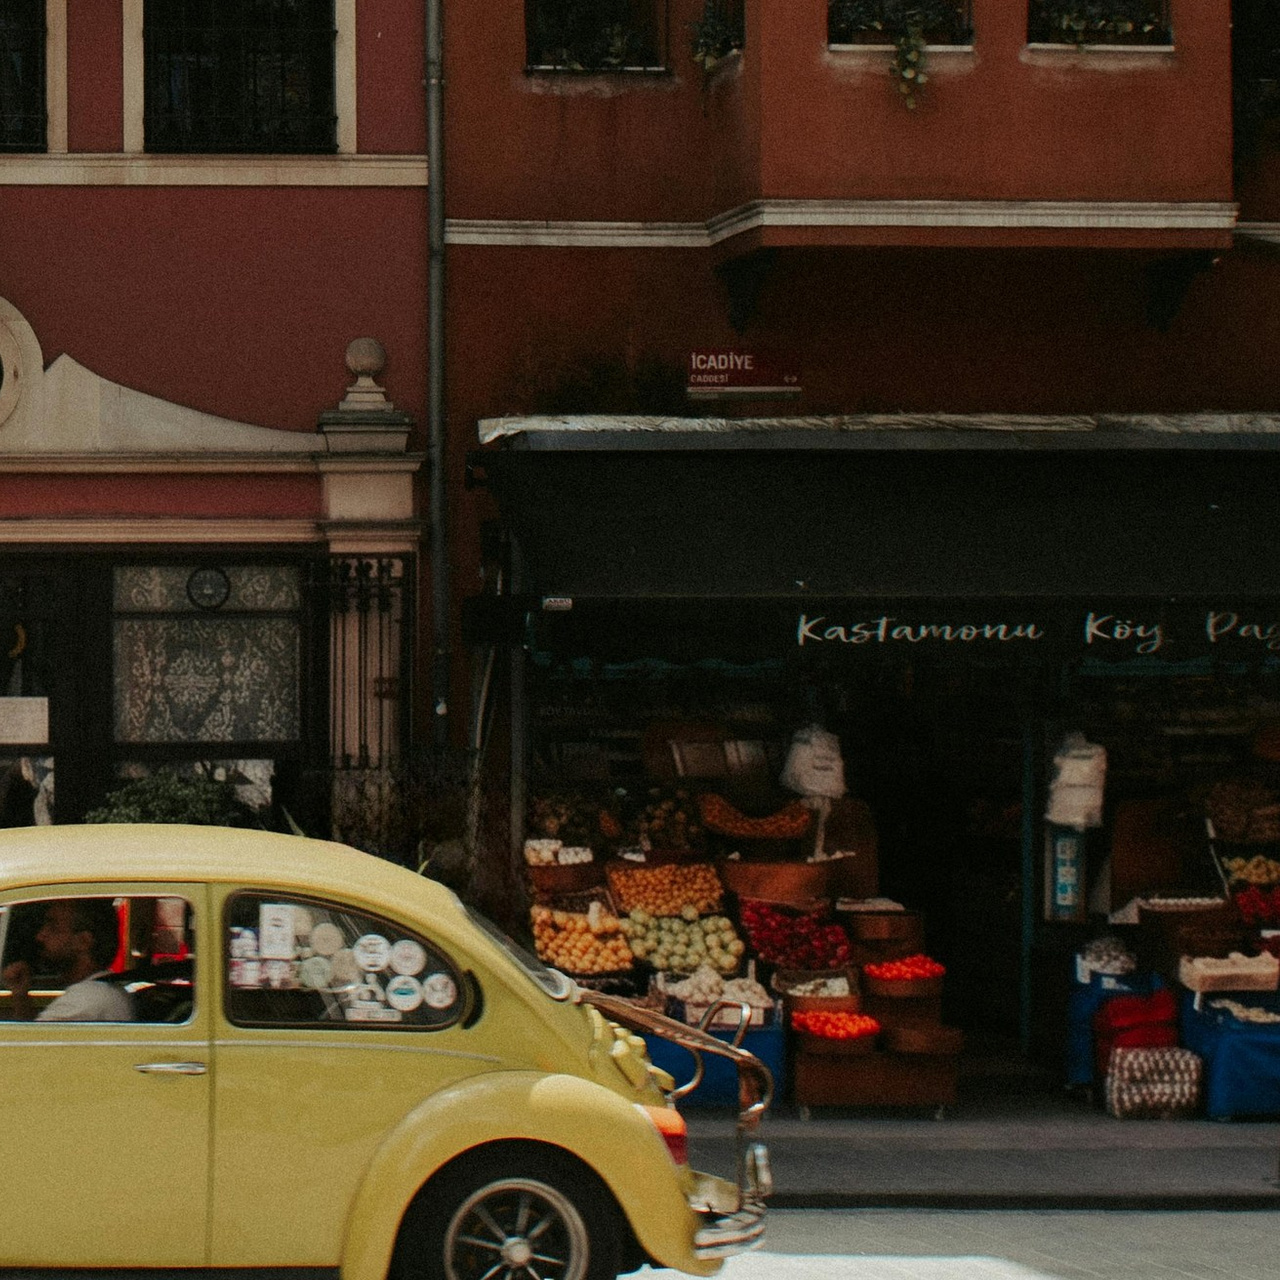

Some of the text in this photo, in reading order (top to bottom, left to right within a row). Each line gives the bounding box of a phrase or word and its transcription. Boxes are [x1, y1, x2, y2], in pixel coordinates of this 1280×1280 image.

[691, 352, 754, 370] İCADİYE
[690, 374, 729, 383] CADDESİ
[797, 614, 1045, 646] Kastamonu
[1084, 611, 1166, 653] Köy
